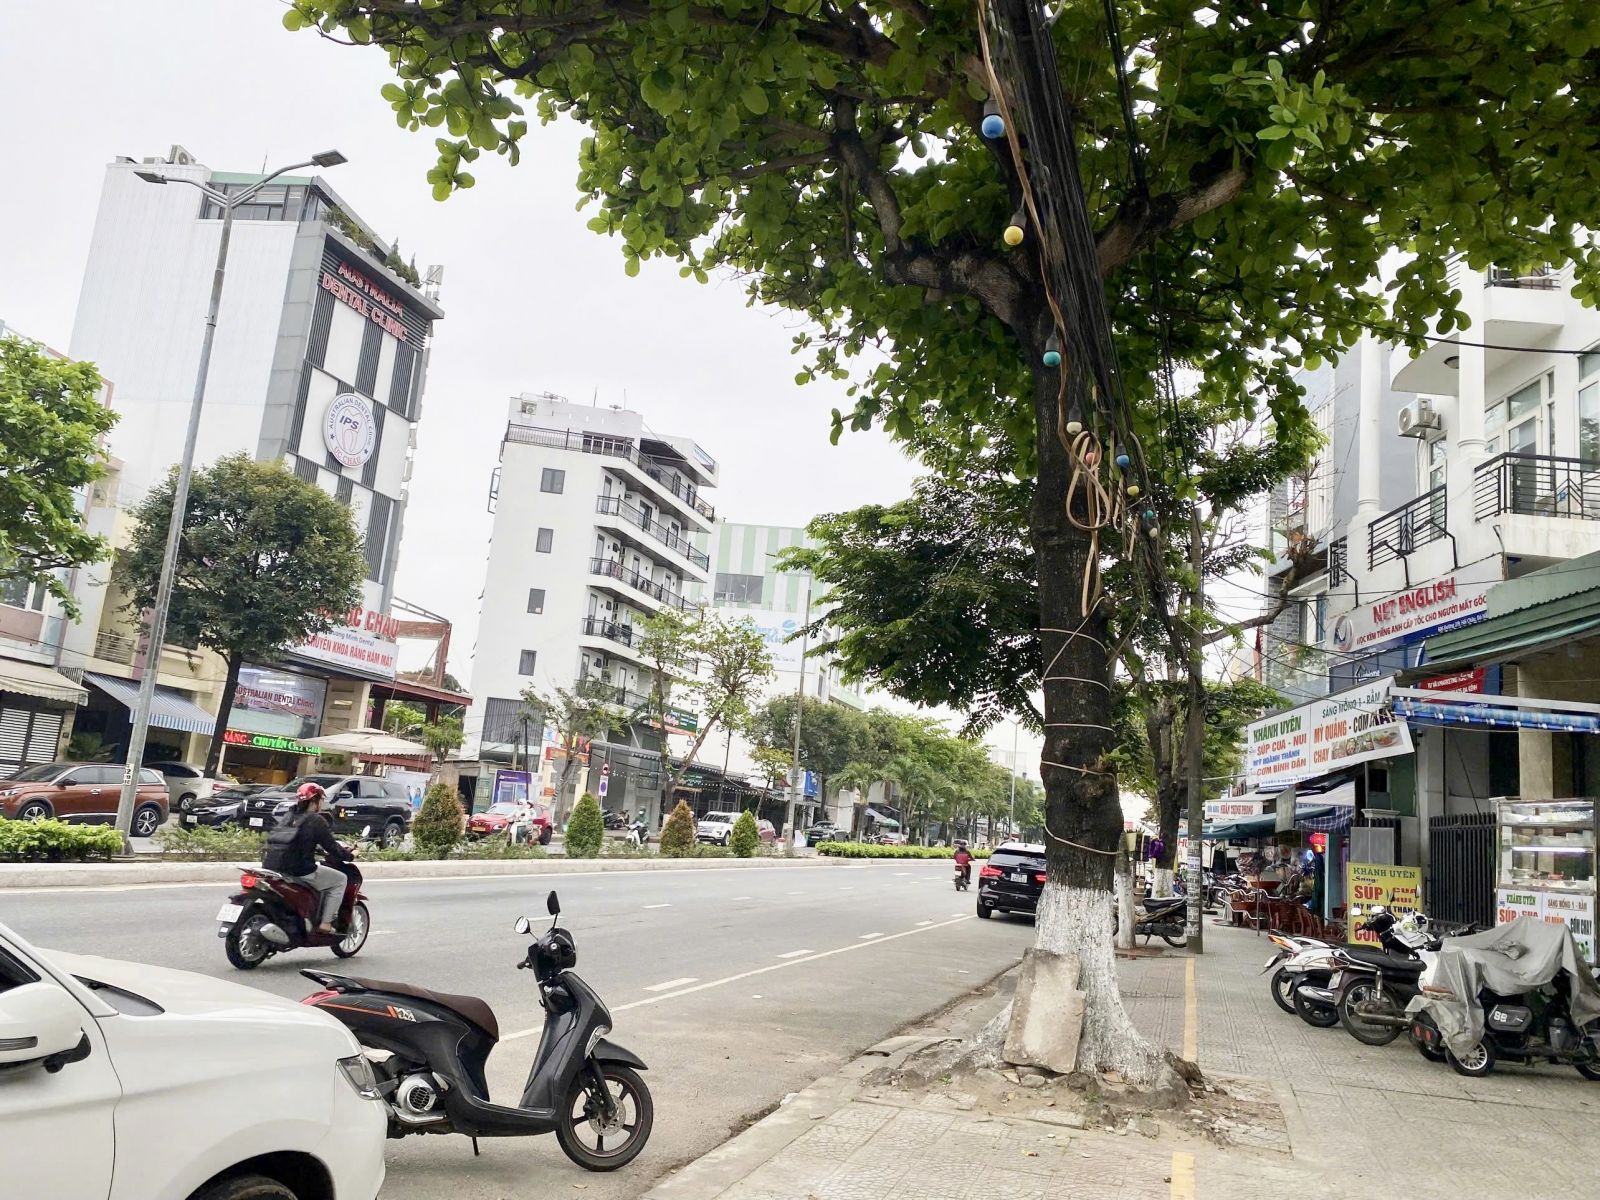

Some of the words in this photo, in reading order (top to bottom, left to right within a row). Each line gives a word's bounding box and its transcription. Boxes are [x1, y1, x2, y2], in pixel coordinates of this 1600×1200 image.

[322, 272, 370, 318] DENTAL
[371, 307, 408, 342] CLINIC
[340, 415, 359, 430] IPS
[1373, 600, 1396, 624] NET
[1399, 577, 1456, 615] ENGLISH
[1392, 624, 1403, 634] ANH
[1425, 613, 1437, 623] CHO
[332, 640, 348, 657] KHOA
[1253, 722, 1279, 743] KHÁNH
[1280, 715, 1302, 735] UYÊN
[1257, 740, 1270, 756] SÚP
[1272, 740, 1286, 753] CUA
[1293, 733, 1307, 747] NUI
[1313, 747, 1330, 764] CHAY
[1499, 907, 1517, 923] SÚP
